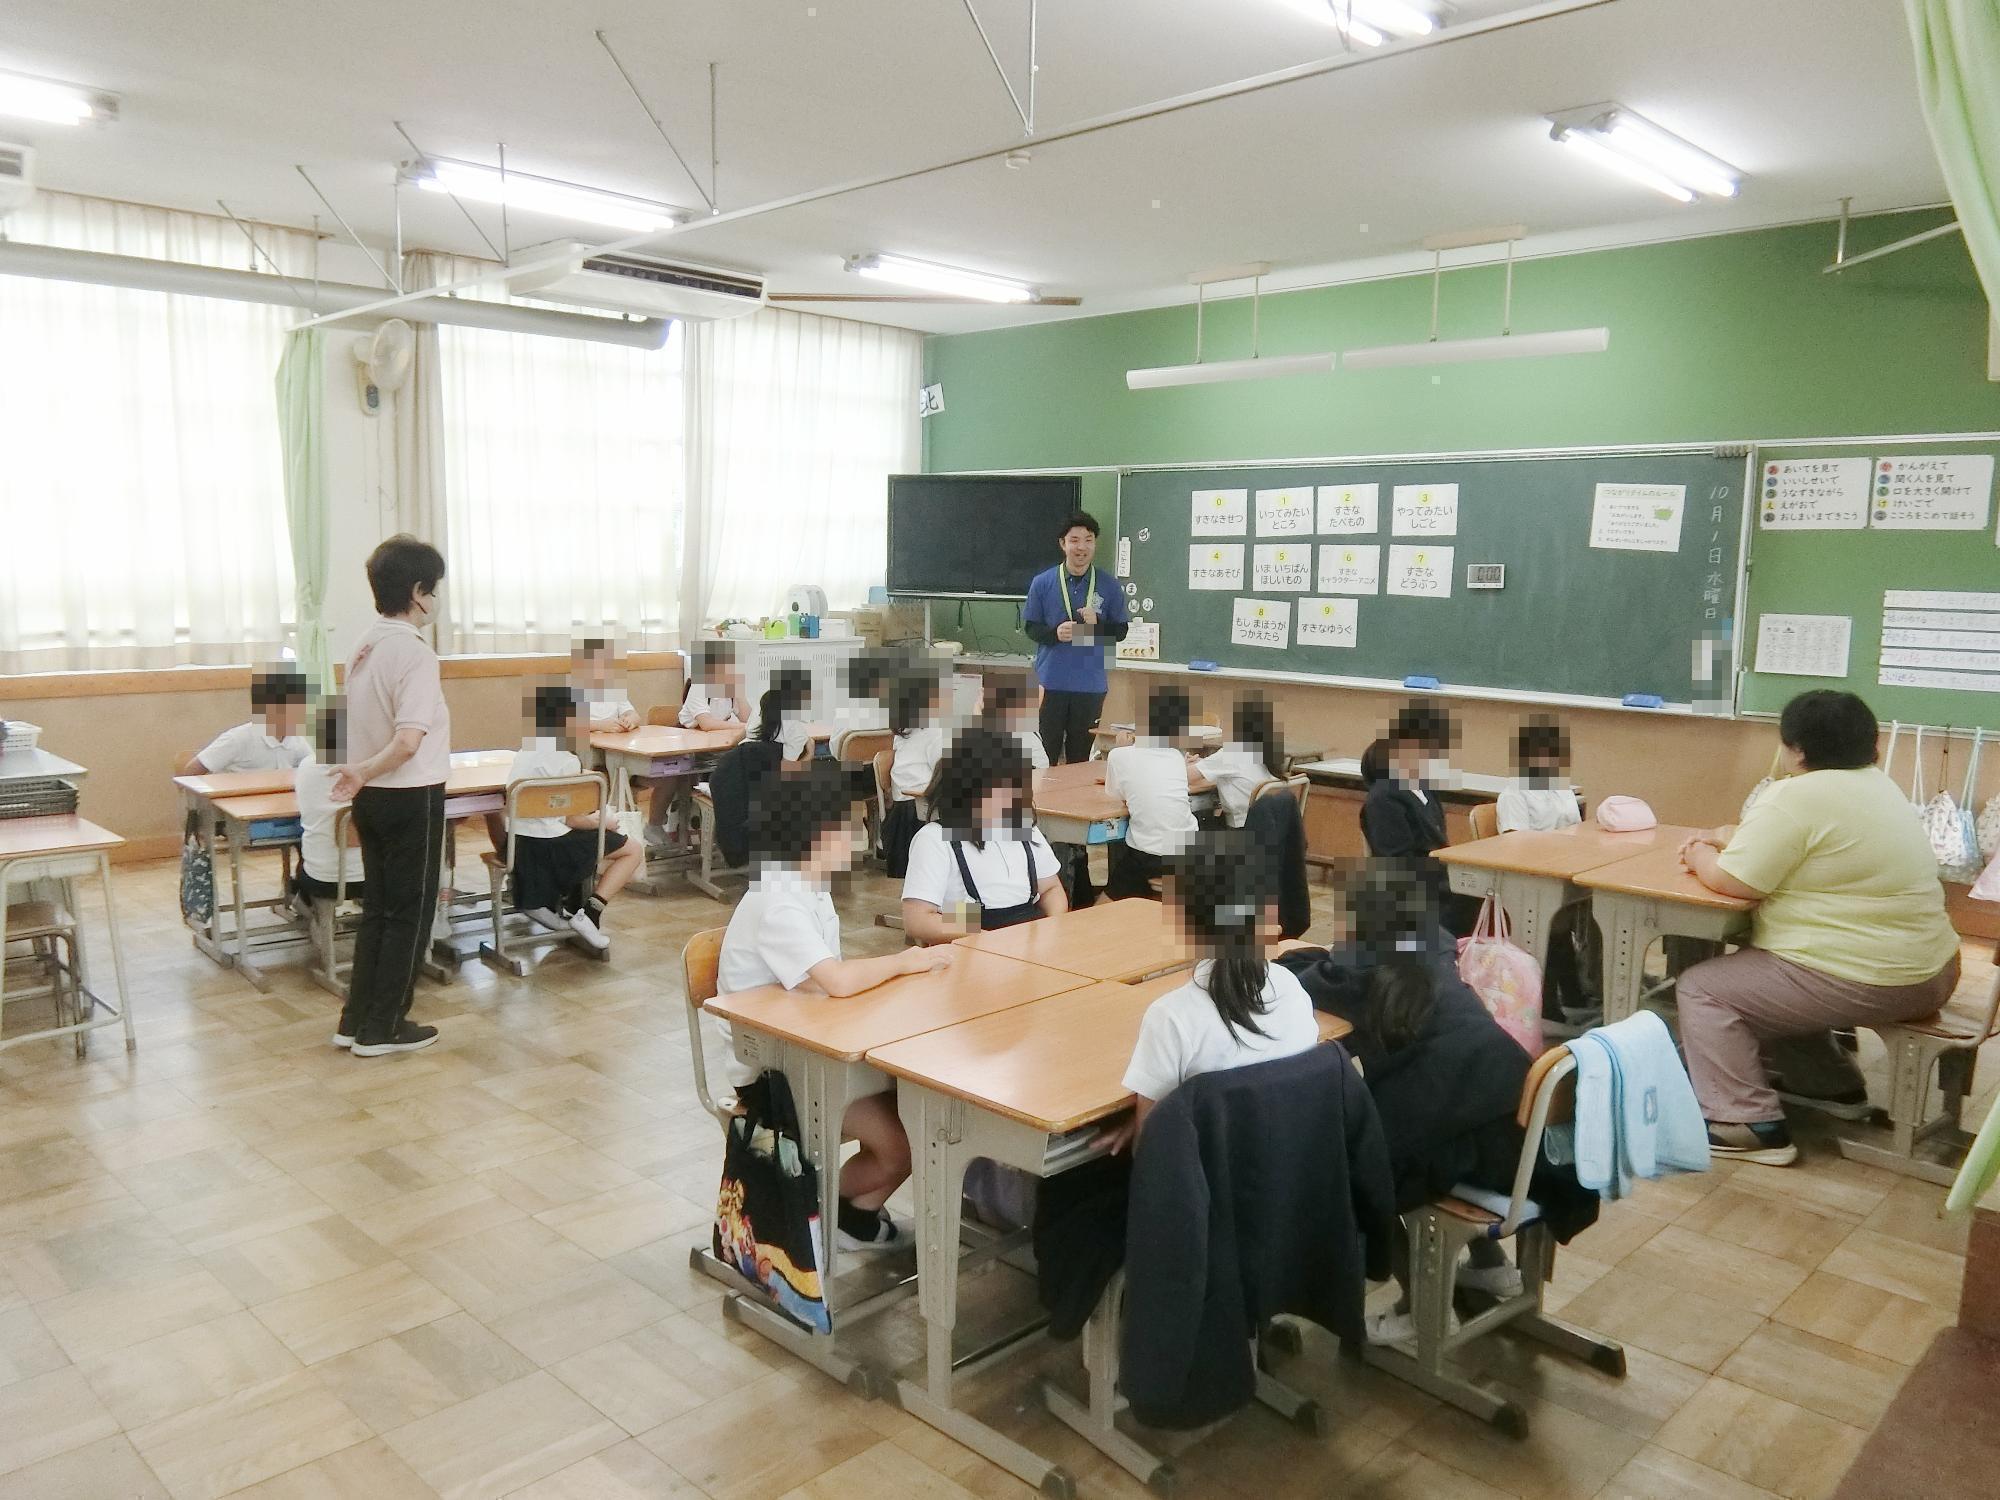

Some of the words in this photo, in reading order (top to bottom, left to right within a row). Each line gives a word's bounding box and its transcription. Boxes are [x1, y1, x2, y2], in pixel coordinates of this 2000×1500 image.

[1784, 464, 1839, 473] あいてを見て
[1898, 462, 1949, 470] かんがえて
[1259, 507, 1310, 520] いってみたい
[1335, 505, 1361, 515] すきな
[1397, 505, 1453, 517] やってみたい
[1195, 514, 1244, 525] すきなきせつ
[1272, 519, 1297, 530] ところ
[1329, 516, 1365, 528] たべもの
[1411, 518, 1437, 529] しごと
[1192, 568, 1240, 579] すきなあそび
[1255, 563, 1272, 573] いま
[1338, 567, 1358, 576] すきな
[1406, 566, 1434, 577] すきな
[1260, 575, 1302, 585] ほしいもの
[1400, 578, 1438, 589] どうぶつ
[1236, 617, 1250, 627] もし
[1302, 623, 1352, 634] すきなゆうぐ
[1239, 629, 1280, 641] つかえたら
